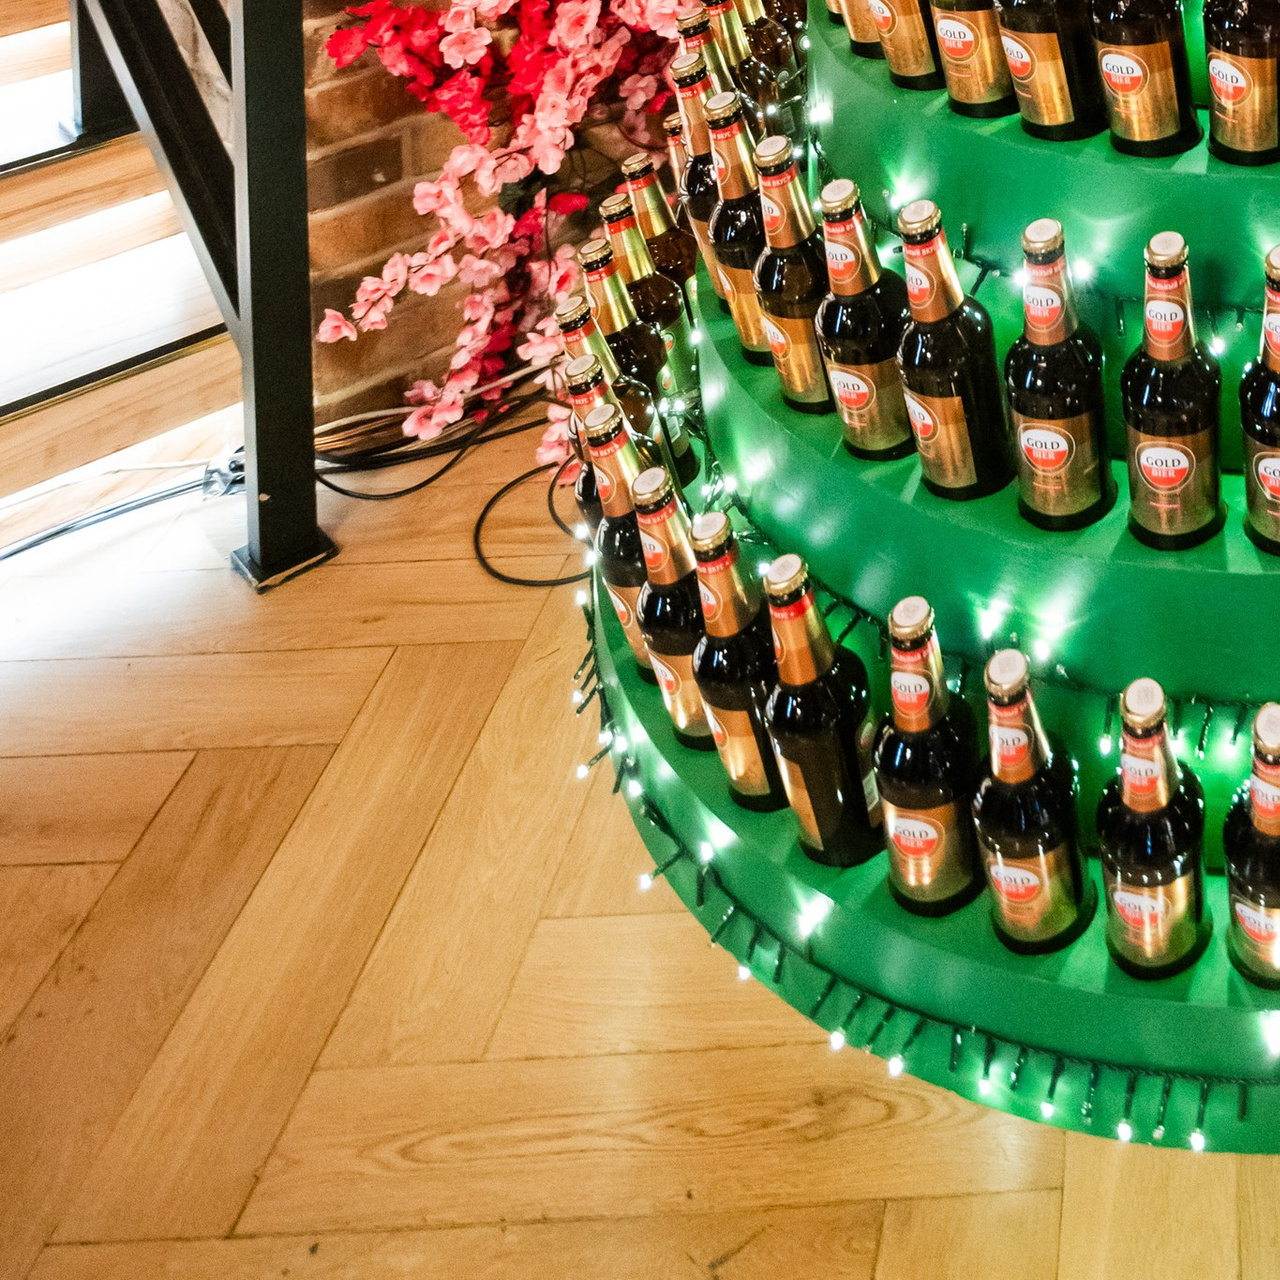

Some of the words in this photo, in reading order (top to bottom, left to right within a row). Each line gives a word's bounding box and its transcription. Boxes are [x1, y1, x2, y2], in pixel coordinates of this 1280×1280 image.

[940, 29, 967, 40] GOLD
[1105, 63, 1135, 75] GOLD
[1211, 65, 1239, 85] GOLD
[1111, 74, 1132, 85] BIER
[828, 252, 848, 262] OLD
[1026, 293, 1055, 308] GOLD
[1028, 306, 1050, 318] BIER
[1148, 310, 1178, 322] GOLD
[1152, 320, 1173, 332] BIER
[1026, 436, 1060, 451] GOLD
[1031, 449, 1056, 461] BIER
[1145, 455, 1181, 468] GOLD
[1151, 467, 1176, 479] BIER
[893, 681, 923, 694] GOLD
[998, 734, 1021, 746] OLD
[894, 825, 929, 840] GOLD
[1118, 898, 1156, 912] GOLD
